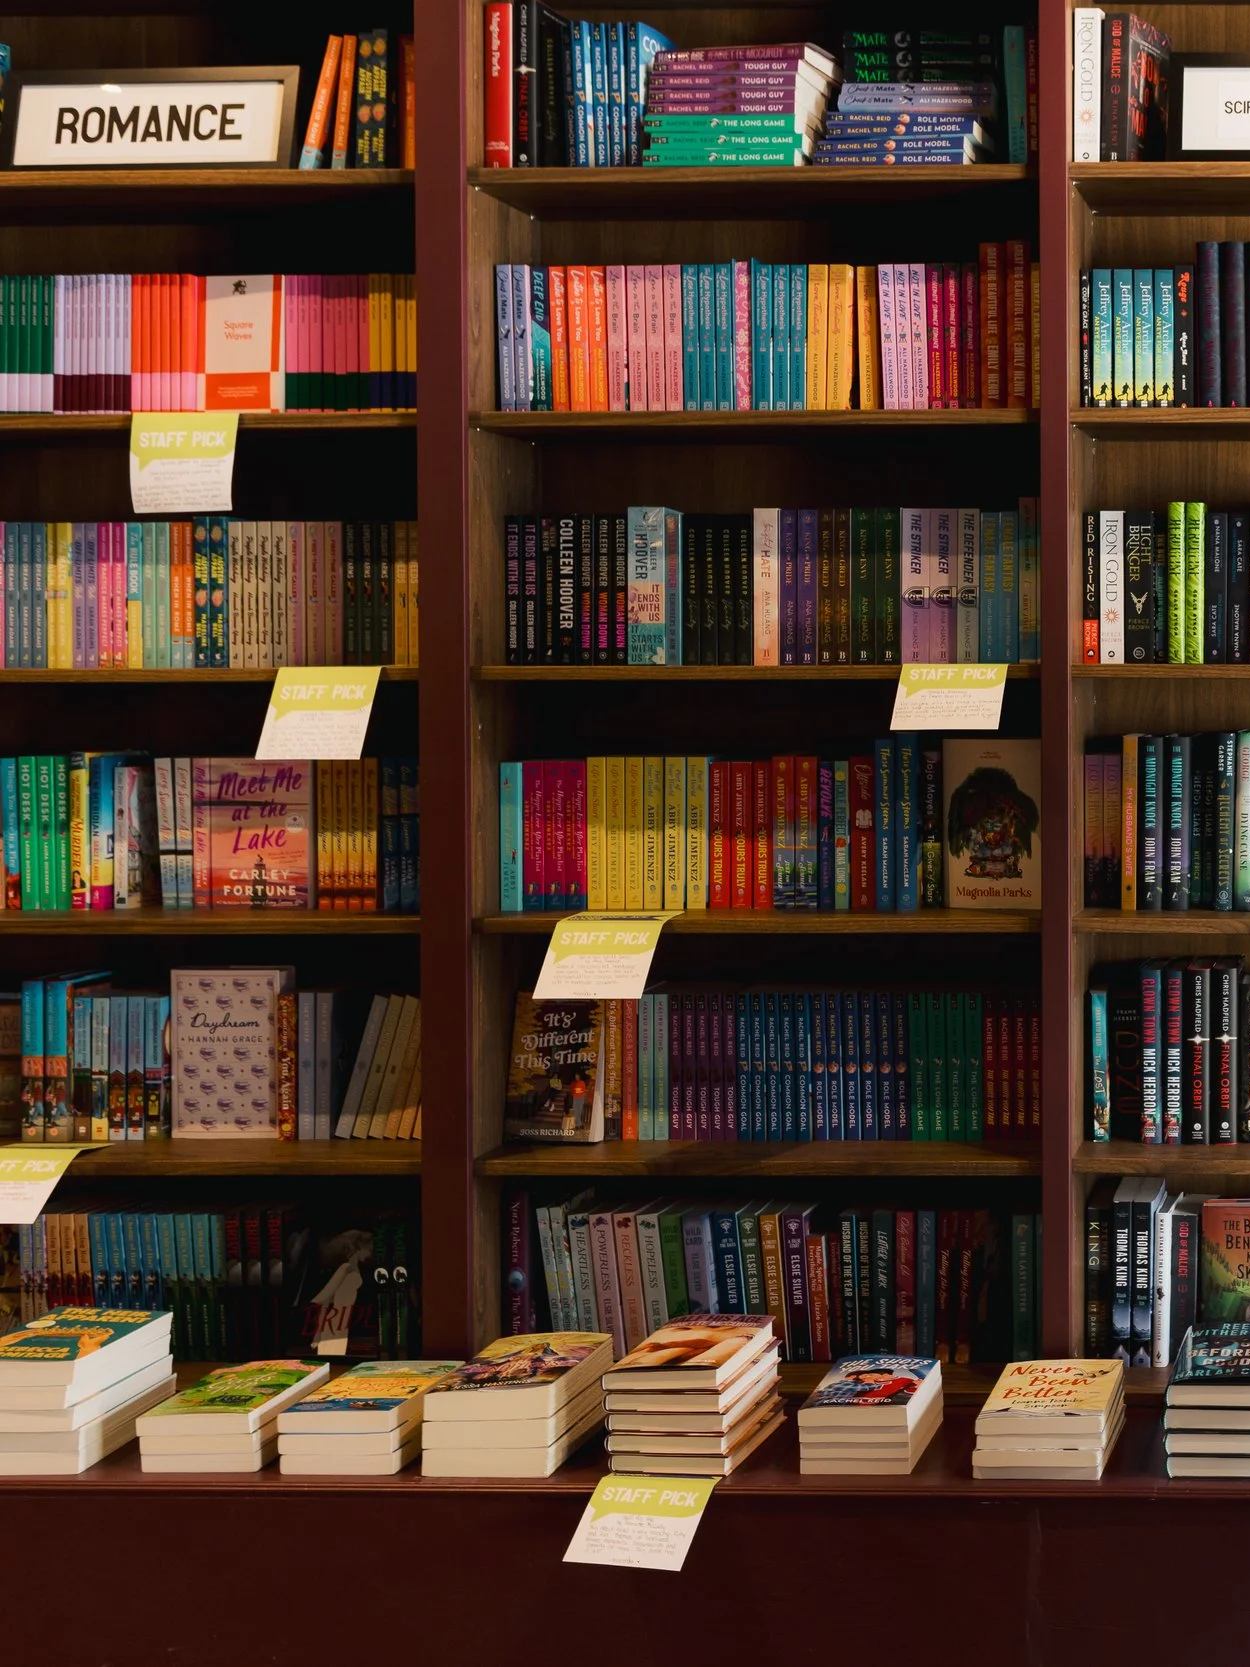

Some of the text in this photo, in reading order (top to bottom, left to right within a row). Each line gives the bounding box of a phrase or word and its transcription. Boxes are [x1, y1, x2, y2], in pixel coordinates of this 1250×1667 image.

[741, 77, 784, 85] TOUGH GUY
[55, 103, 245, 144] ROMANCE
[723, 119, 785, 127] THE LONG GAME
[533, 271, 545, 321] DEEP END
[1160, 281, 1172, 316] Jeffrey
[224, 321, 254, 331] Square
[224, 332, 252, 340] Waves
[139, 430, 228, 448] STAFF PICK
[1139, 525, 1152, 555] LIGHT
[1086, 515, 1097, 602] RED RISING
[1102, 518, 1120, 602] IRON GOLD
[1127, 525, 1142, 582] BRINGER
[560, 519, 574, 629] COLLEEN HOOVER
[1084, 622, 1092, 648] BROWN
[910, 668, 997, 680] STAFF PICK
[279, 685, 367, 700] STAFF PICK
[217, 767, 302, 800] Meet Me
[40, 766, 51, 821] HOT DESK
[232, 801, 287, 822] at the
[1170, 758, 1184, 883] MIDNIGHT KNOCK JOHN FRAM
[232, 826, 288, 854] Lake
[229, 869, 289, 881] CARLEY
[223, 884, 297, 896] FORTUNE
[956, 886, 1032, 900] Magnolia Parks
[560, 932, 650, 945] STAFF PICK
[190, 1013, 260, 1034] Daydream
[544, 1012, 577, 1027] It's
[188, 1036, 263, 1044] HANNAH GRACE
[521, 1032, 594, 1050] Different
[1167, 978, 1181, 1115] CLOWN TOWN MICK HERRON
[1192, 975, 1203, 1111] CHRIS HADFIELD FINAL ORBIT
[515, 1049, 597, 1070] This Time
[540, 1128, 575, 1136] RICHARD
[22, 1160, 59, 1172] PICK
[1223, 1220, 1240, 1231] THE
[596, 1229, 610, 1291] POWERLESS
[1135, 1230, 1149, 1289] THOMAS KING
[38, 1314, 152, 1323] APPARENT
[62, 1308, 152, 1318] THE HEIR
[1011, 1365, 1077, 1377] Never
[1028, 1376, 1097, 1388] Been
[1003, 1388, 1078, 1401] Better
[602, 1487, 700, 1507] STAFF PICK
